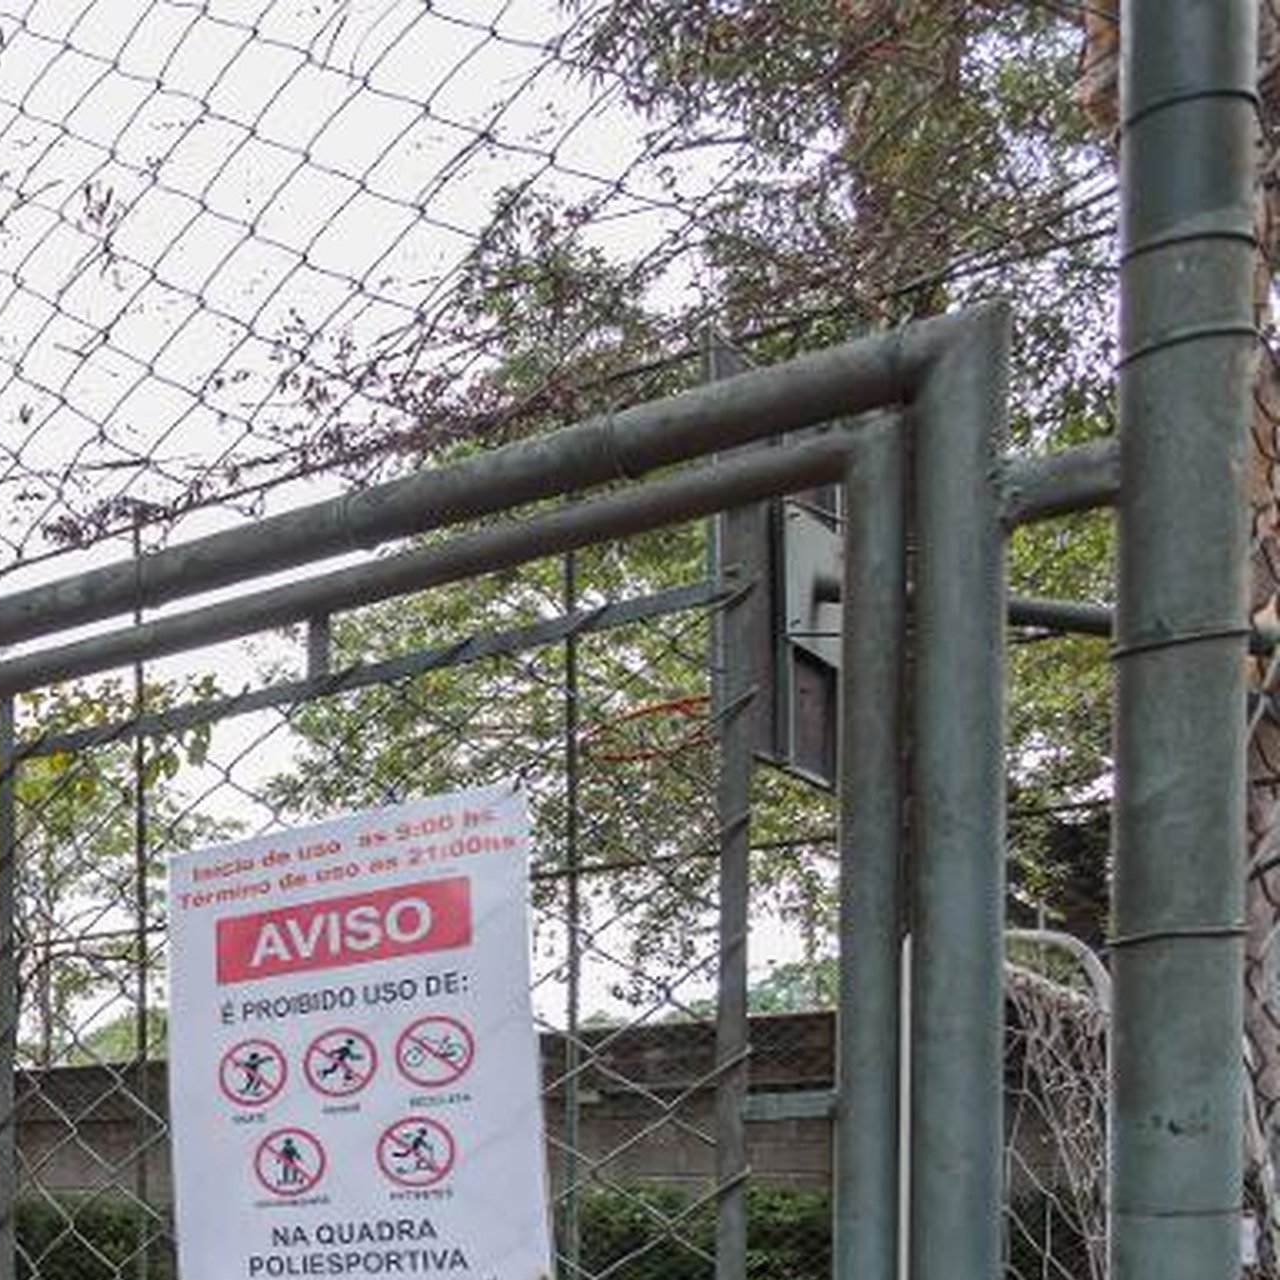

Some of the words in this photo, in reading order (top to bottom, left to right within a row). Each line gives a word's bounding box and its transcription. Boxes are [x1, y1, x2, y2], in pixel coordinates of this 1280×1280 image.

[263, 850, 291, 868] de
[299, 840, 340, 860] uso
[279, 872, 307, 891] de
[316, 862, 360, 881] uso
[249, 898, 433, 969] AVISO
[221, 997, 235, 1026] É
[242, 987, 355, 1020] PROIBIDO
[363, 979, 418, 1006] USO
[426, 972, 471, 996] DE:
[272, 1226, 308, 1248] NA
[316, 1219, 438, 1247] QUADRA
[249, 1249, 470, 1279] POLIESPORTIVA
